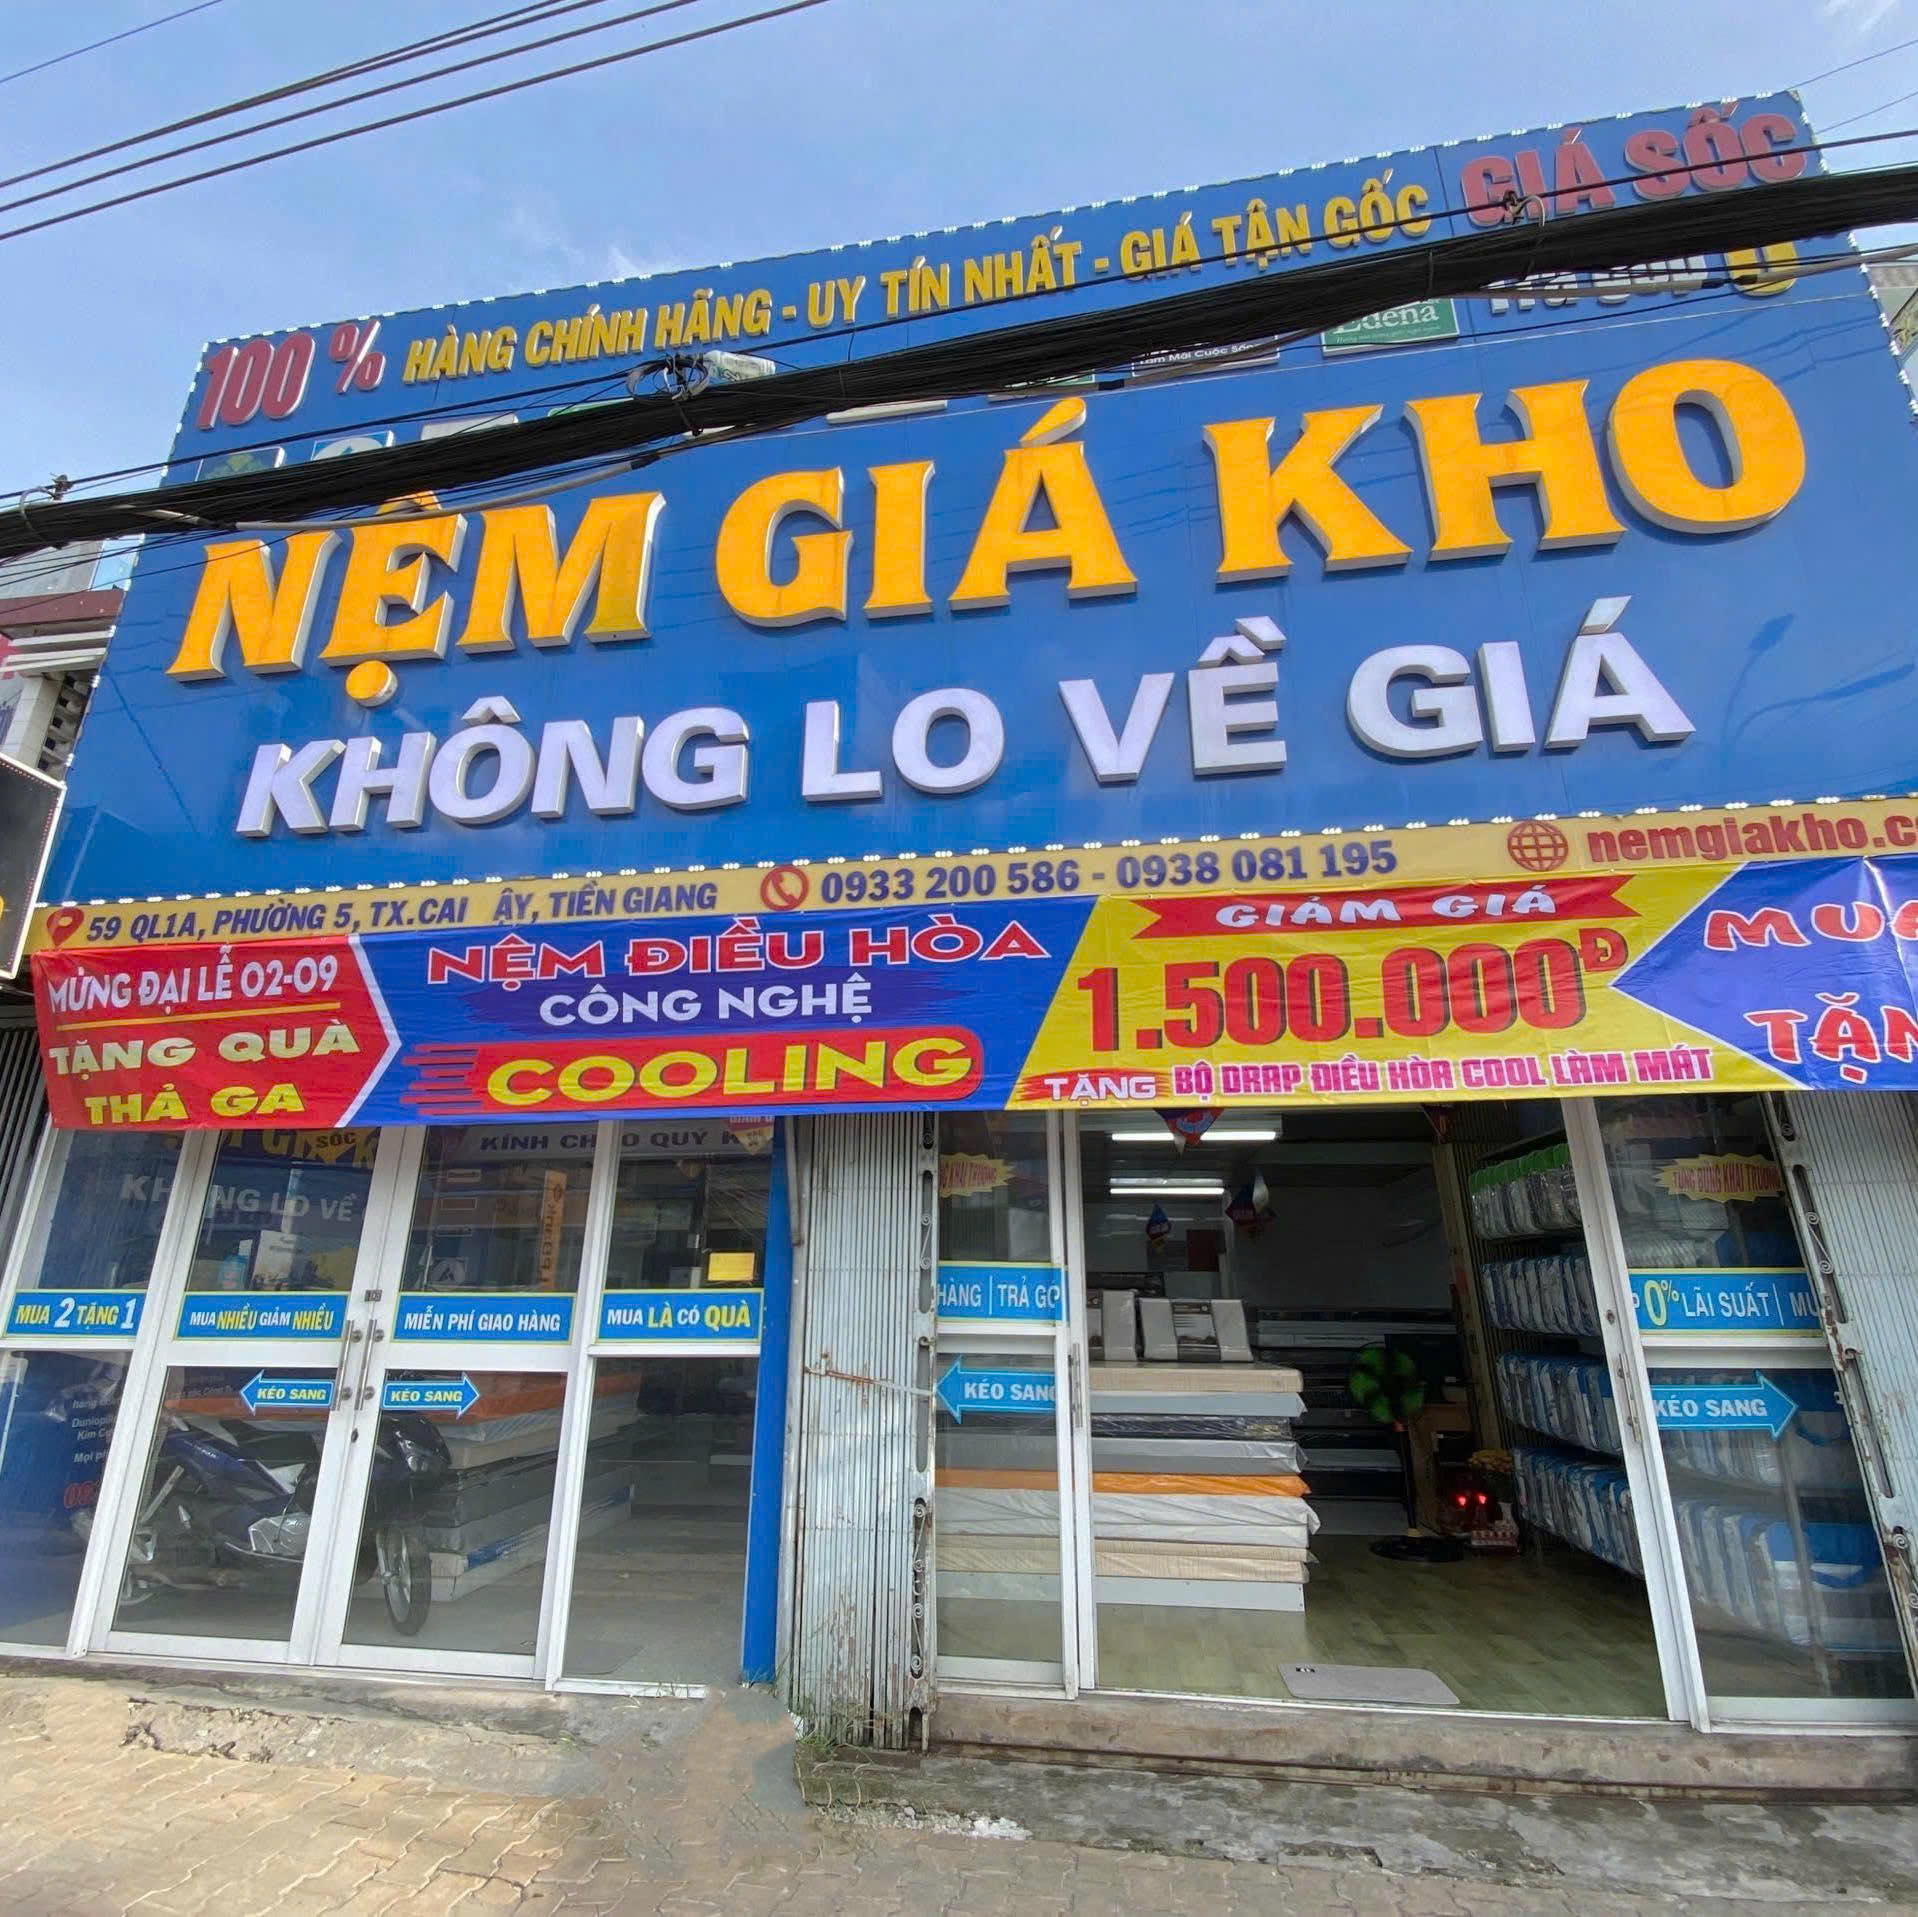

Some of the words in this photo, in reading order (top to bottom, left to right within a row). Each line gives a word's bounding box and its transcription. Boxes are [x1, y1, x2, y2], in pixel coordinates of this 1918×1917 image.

[198, 332, 315, 430] 100
[329, 318, 387, 395] %
[403, 324, 518, 385] HÀNG
[525, 303, 649, 367] CHÍNH
[654, 288, 772, 349] HÃNG
[807, 275, 866, 328] UY
[880, 256, 950, 318] TÍN
[964, 226, 1083, 305] NHẤT
[1120, 211, 1201, 280] GIÁ
[1211, 197, 1312, 271] TẬN
[1324, 168, 1432, 248] GỐC
[1461, 127, 1615, 228] GIÁ
[1624, 100, 1807, 201] SỐC
[164, 490, 666, 708] NỆM
[715, 396, 1138, 628] GIÁ
[1202, 358, 1806, 584] KHO
[236, 696, 749, 838] KHÔNG
[801, 687, 1004, 802] LO
[1058, 615, 1287, 784] VỀ
[1347, 594, 1696, 759] GIÁ
[1587, 812, 1918, 863] nemgiakho.c
[821, 868, 914, 903] 0933
[925, 864, 996, 899] 200
[1007, 859, 1080, 894] 586
[1116, 850, 1220, 889] 0938
[1231, 846, 1308, 882] 081
[1319, 839, 1398, 877] 195
[86, 916, 122, 941] 59
[131, 914, 205, 943] QL1A,
[211, 898, 326, 936] PHƯỜNG
[333, 903, 360, 932] 5,
[549, 880, 617, 918] TIỀN
[622, 882, 719, 913] GIANG
[1215, 895, 1403, 928] GIẢM
[1432, 884, 1558, 918] GIÁ
[427, 932, 606, 992] NỆM
[625, 915, 824, 977] ĐIỀU
[849, 912, 1052, 967] HÒA
[138, 966, 191, 1015] ĐẠI
[198, 944, 234, 1001] LỄ
[241, 954, 338, 998] 02-09
[539, 984, 701, 1026] CÔNG
[718, 971, 872, 1024] NGHỆ
[1077, 927, 1630, 1052] 1.500.000Đ
[50, 1036, 196, 1081] TẶNG
[218, 1017, 361, 1063] QUÀ
[487, 1036, 973, 1107] COOLING
[1044, 1073, 1157, 1107] TẶNG
[1173, 1060, 1213, 1102] BỘ
[1220, 1064, 1302, 1096] DRAP
[1309, 1053, 1381, 1092] ĐIỀU
[1386, 1054, 1455, 1091] HÒA
[1459, 1055, 1548, 1088] COOL
[1550, 1048, 1629, 1086] LÀM
[1633, 1043, 1712, 1082] MÁT
[84, 1083, 190, 1126] THẢ
[210, 1083, 305, 1117] GA
[560, 1130, 640, 1150] CHO
[120, 1173, 262, 1213] KHNG
[15, 1305, 50, 1324] MUA
[54, 1297, 76, 1328] 2
[76, 1302, 120, 1330] TẶNG
[120, 1298, 137, 1329] 1
[997, 1275, 1029, 1308] TRẢ
[1682, 1286, 1715, 1317] LÃI
[1718, 1281, 1769, 1318] SUẤT
[189, 1311, 215, 1326] MUA
[216, 1302, 258, 1330] NHIỀU
[259, 1306, 291, 1327] GIẢM
[292, 1302, 334, 1330] NHIỀU
[404, 1305, 443, 1331] MIỄN
[448, 1308, 475, 1331] PHÍ
[477, 1311, 514, 1332] GIAO
[518, 1309, 561, 1332] HÀNG
[606, 1307, 643, 1326] MUA
[647, 1302, 673, 1328] LÀ
[677, 1303, 700, 1325] CÓ
[704, 1300, 751, 1332] QUÀ
[257, 1385, 286, 1400] KÉO
[289, 1388, 327, 1401] SANG
[391, 1389, 421, 1402] KÉO
[424, 1390, 463, 1402] SANG
[964, 1378, 1005, 1400] KÉO
[1705, 1399, 1768, 1417] SANG
